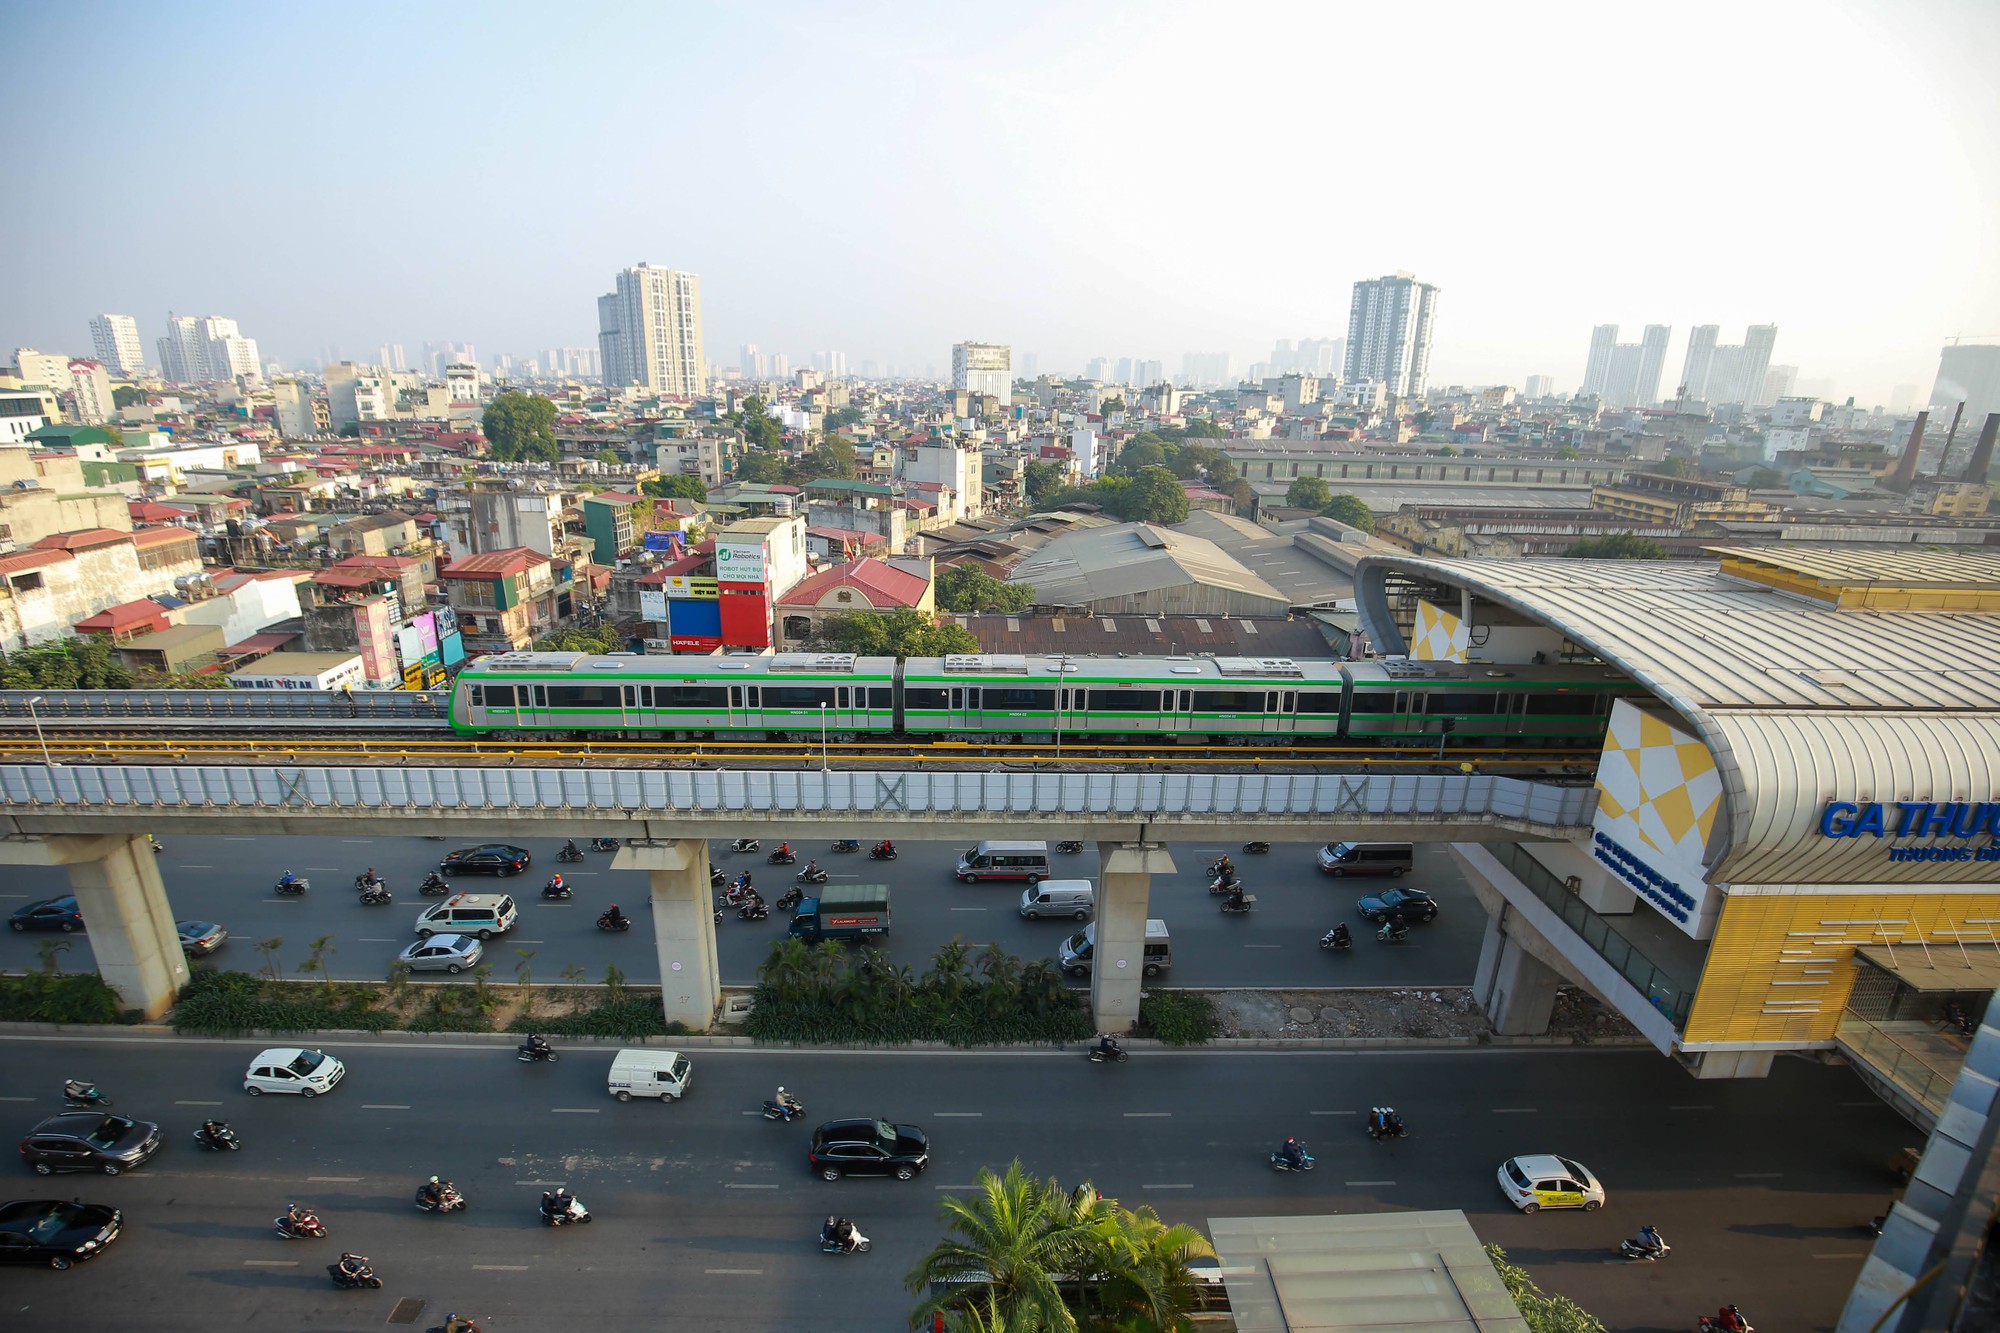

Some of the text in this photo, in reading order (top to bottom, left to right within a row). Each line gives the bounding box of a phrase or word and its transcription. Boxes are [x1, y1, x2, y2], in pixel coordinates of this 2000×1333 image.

[275, 678, 297, 690] VIỆT
[300, 680, 312, 689] AN
[1821, 802, 1884, 838] GA
[1888, 846, 1973, 862] THUONG
